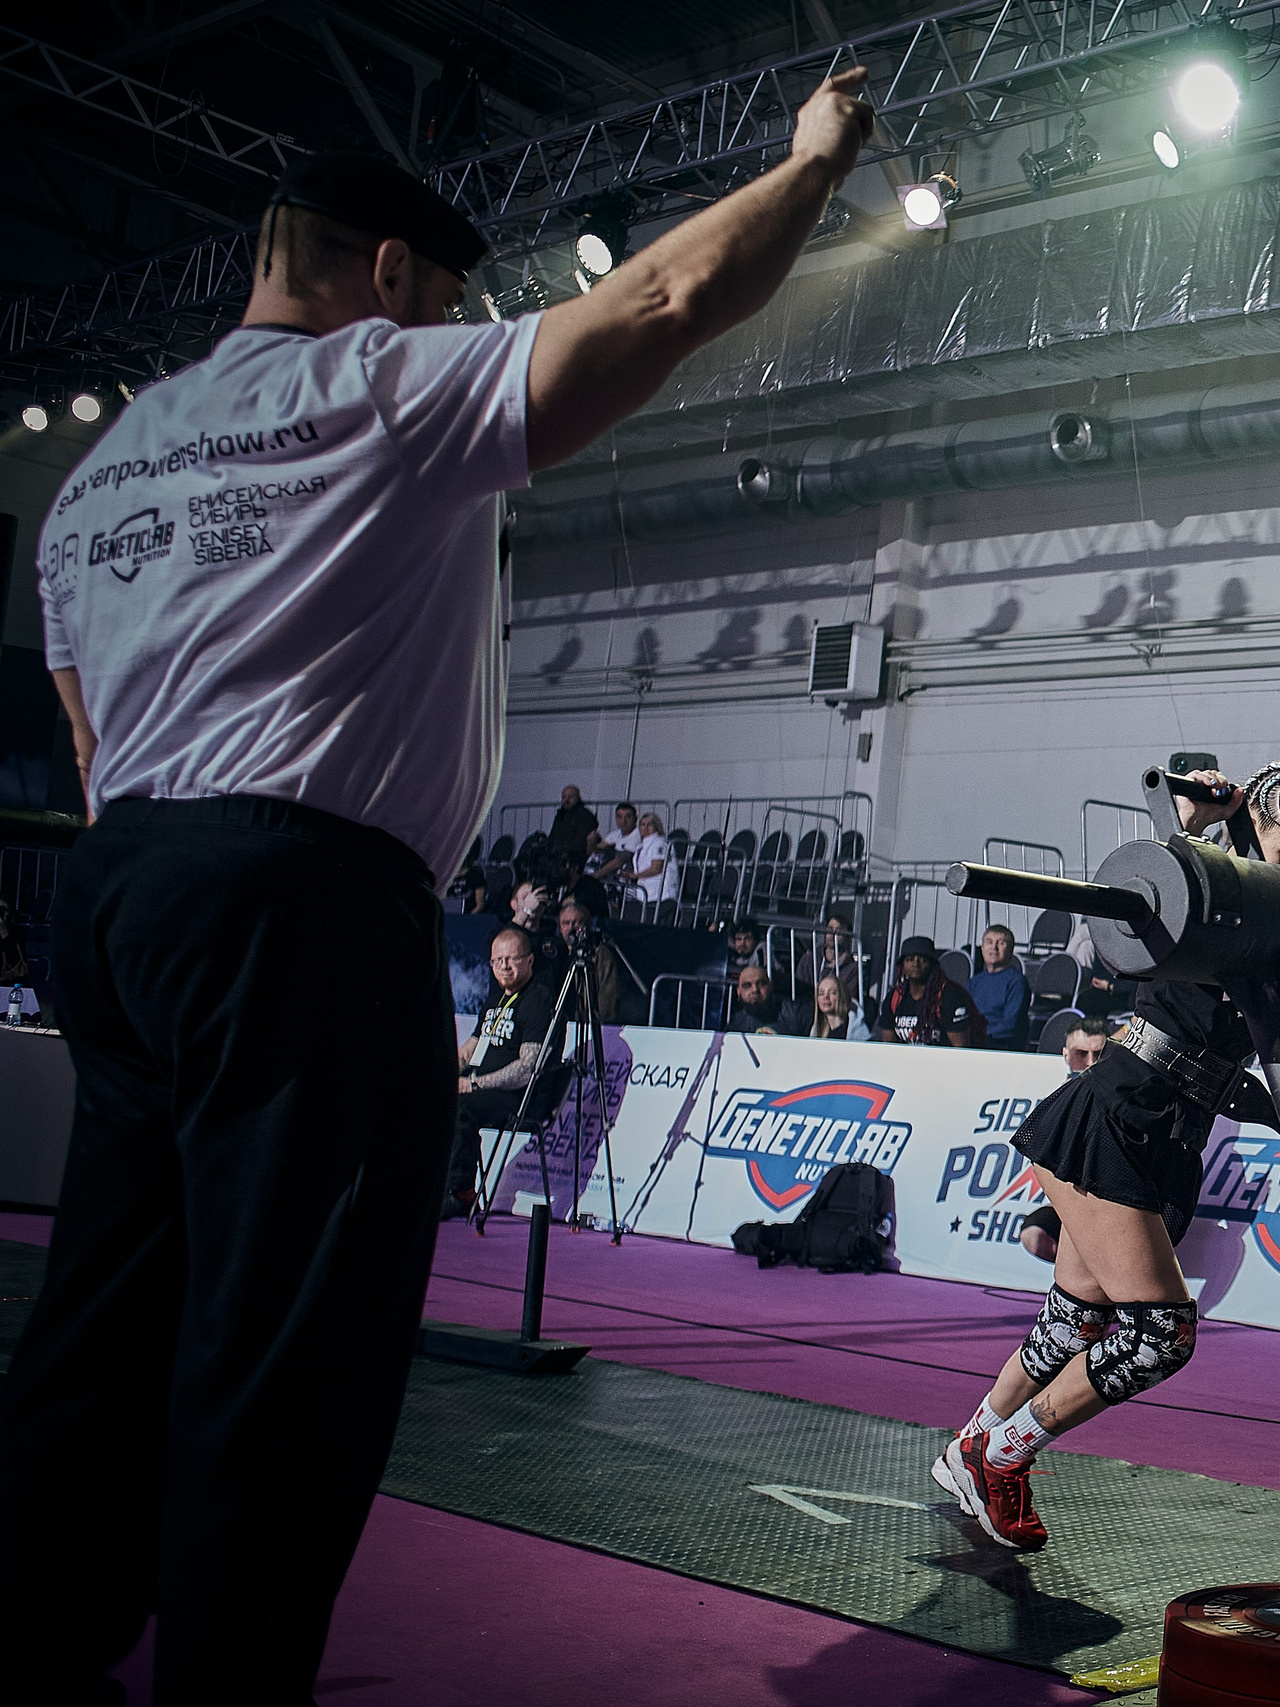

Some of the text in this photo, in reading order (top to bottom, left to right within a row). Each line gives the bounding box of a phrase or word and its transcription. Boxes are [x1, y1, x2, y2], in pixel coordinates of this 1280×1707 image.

[57, 420, 320, 515] sanpowershow.ru
[188, 476, 327, 513] ЕНИСЕЙСКАЯ
[189, 503, 267, 528] СИБИРЬ
[88, 521, 175, 566] GENETICLAB
[188, 522, 270, 550] YENISEY
[132, 548, 171, 566] NUTRITION
[194, 539, 275, 566] SIBERIA
[708, 1092, 909, 1170] GENETICLAB
[973, 1098, 1046, 1134] SIB
[1202, 1593, 1250, 1618] FASTER
